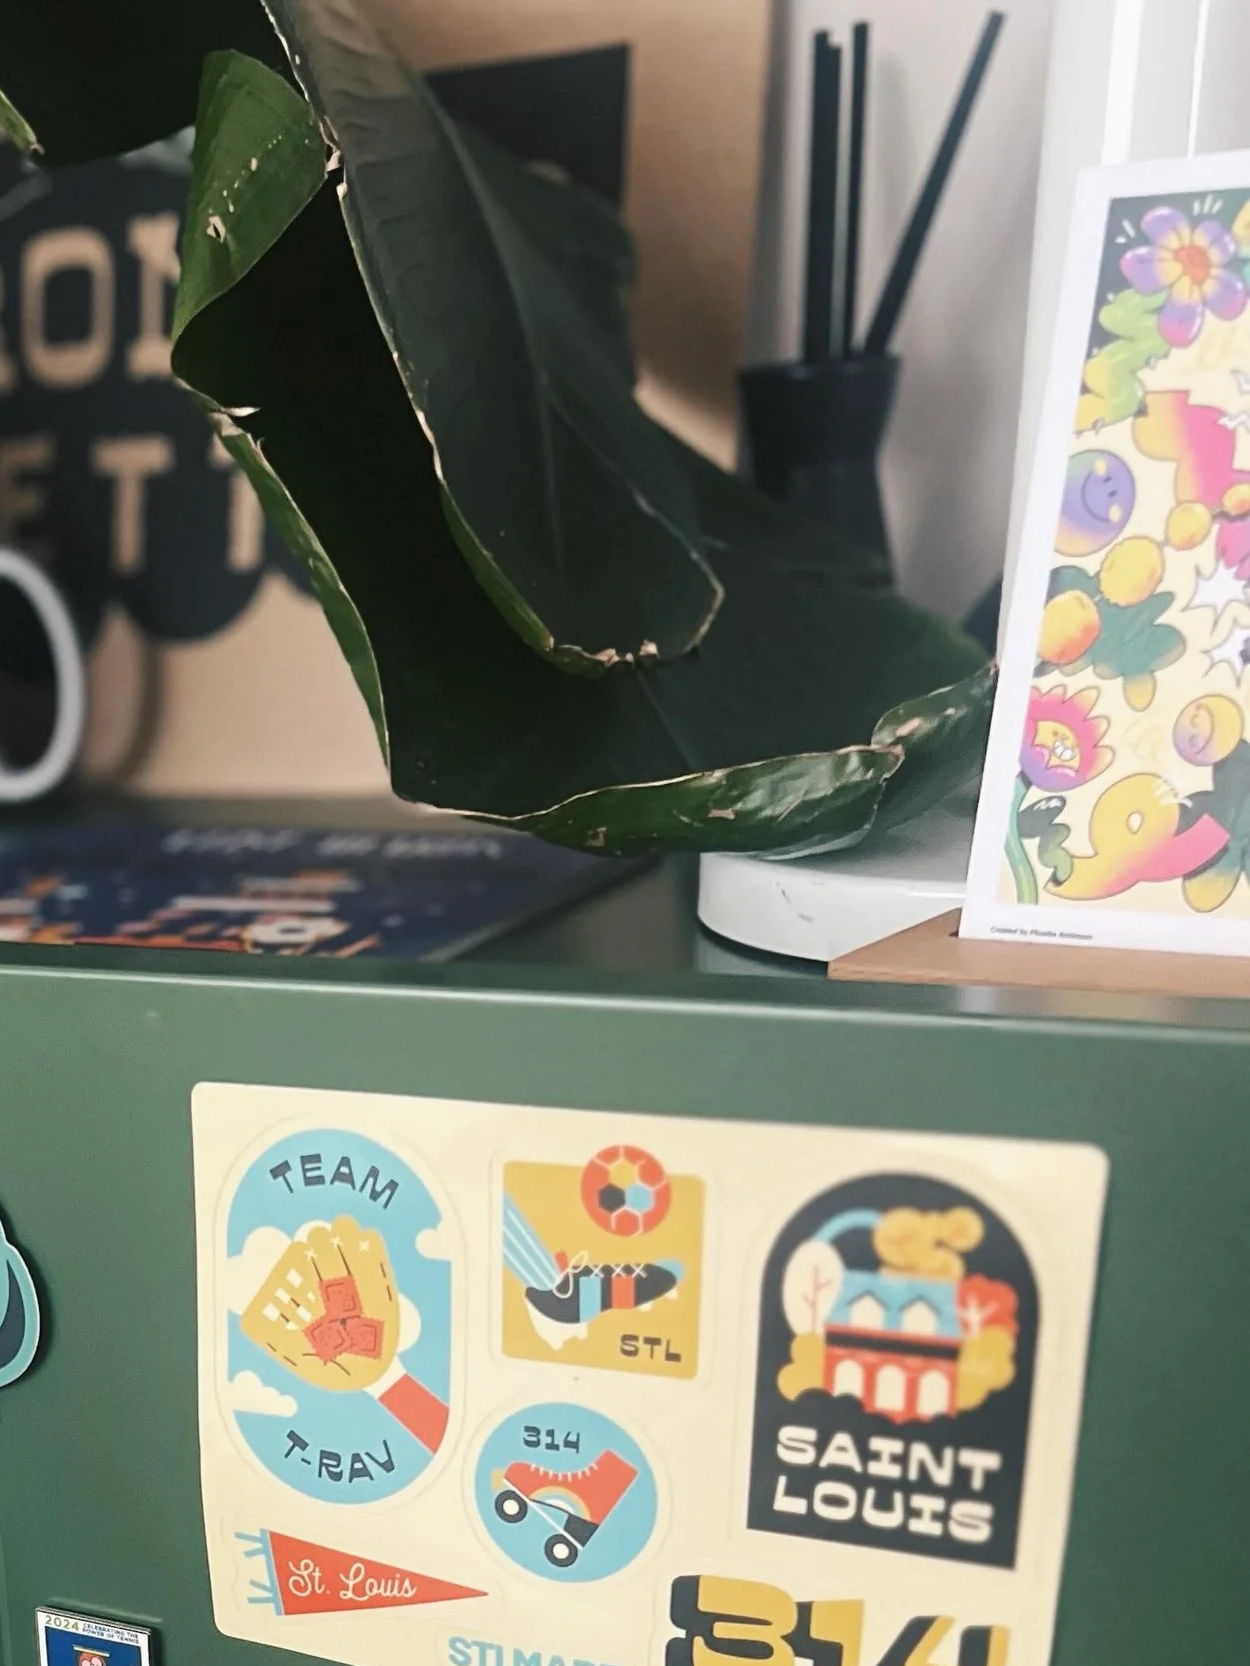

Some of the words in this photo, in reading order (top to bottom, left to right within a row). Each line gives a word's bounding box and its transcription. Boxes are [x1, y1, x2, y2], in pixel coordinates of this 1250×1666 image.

[270, 1153, 400, 1210] TEAM
[619, 1333, 682, 1363] STL
[283, 1430, 397, 1484] T-RAV
[522, 1425, 581, 1454] 314
[776, 1425, 1002, 1491] SAINT
[773, 1475, 995, 1544] LOUIS
[287, 1558, 331, 1597] St.
[339, 1561, 418, 1601] Louis
[45, 1614, 80, 1632] 2024
[82, 1628, 104, 1638] POWER
